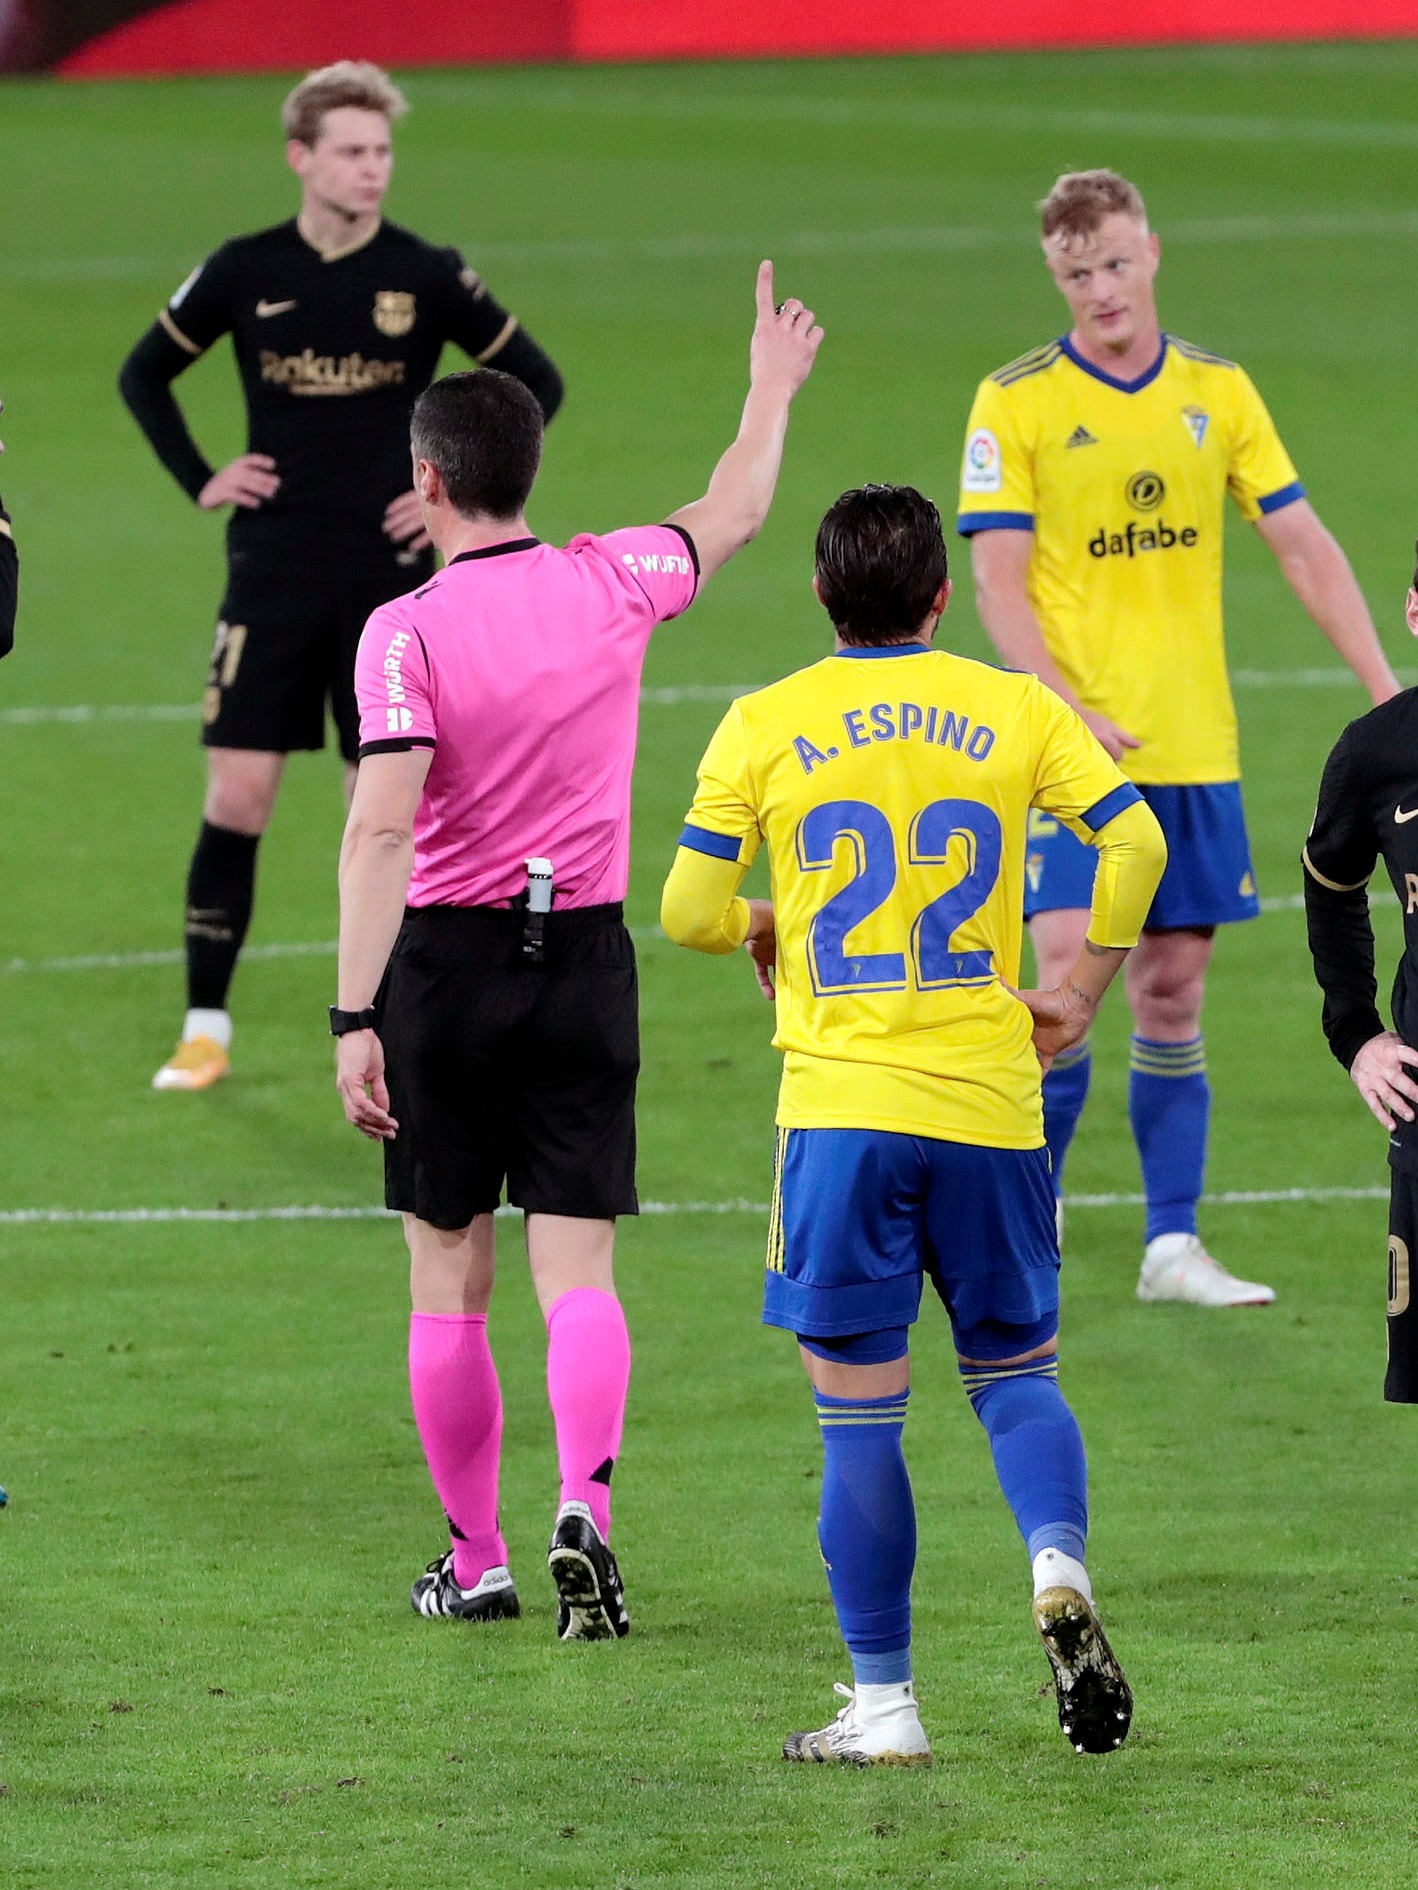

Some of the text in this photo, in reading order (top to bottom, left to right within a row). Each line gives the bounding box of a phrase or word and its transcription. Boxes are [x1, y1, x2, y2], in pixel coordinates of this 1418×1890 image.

[792, 702, 996, 775] A. ESPINO
[796, 798, 1006, 997] 22
